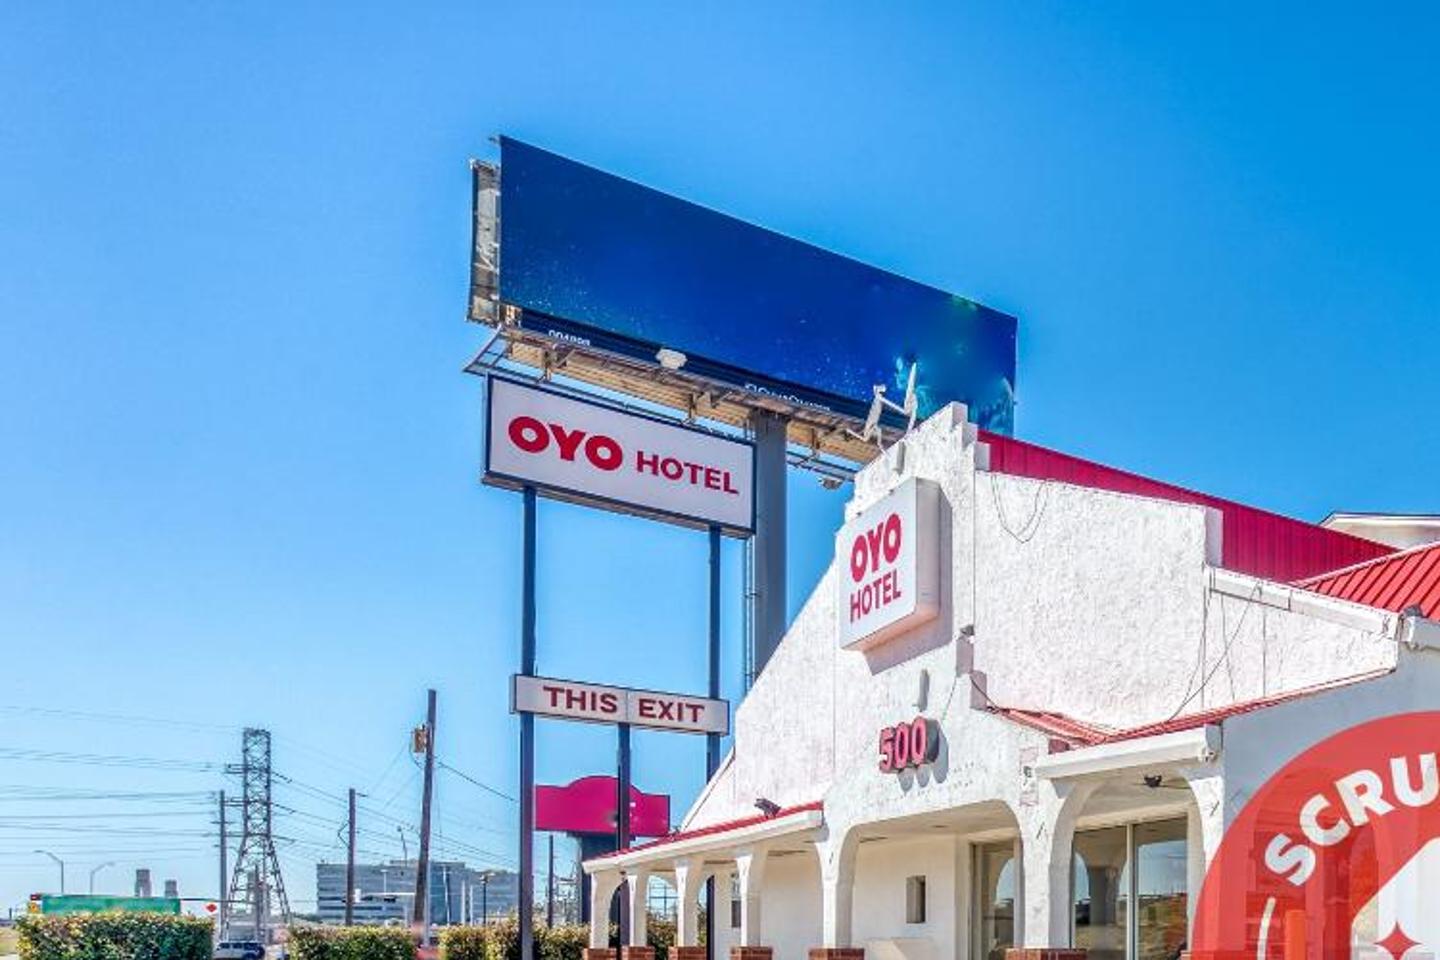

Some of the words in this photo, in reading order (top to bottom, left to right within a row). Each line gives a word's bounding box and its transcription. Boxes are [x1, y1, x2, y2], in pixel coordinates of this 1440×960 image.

[508, 416, 623, 471] OYO
[636, 450, 739, 495] HOTEL
[850, 513, 902, 583] OYO
[850, 569, 902, 624] HOTEL
[543, 686, 618, 713] THIS
[638, 698, 705, 722] EXIT
[879, 716, 928, 773] 500
